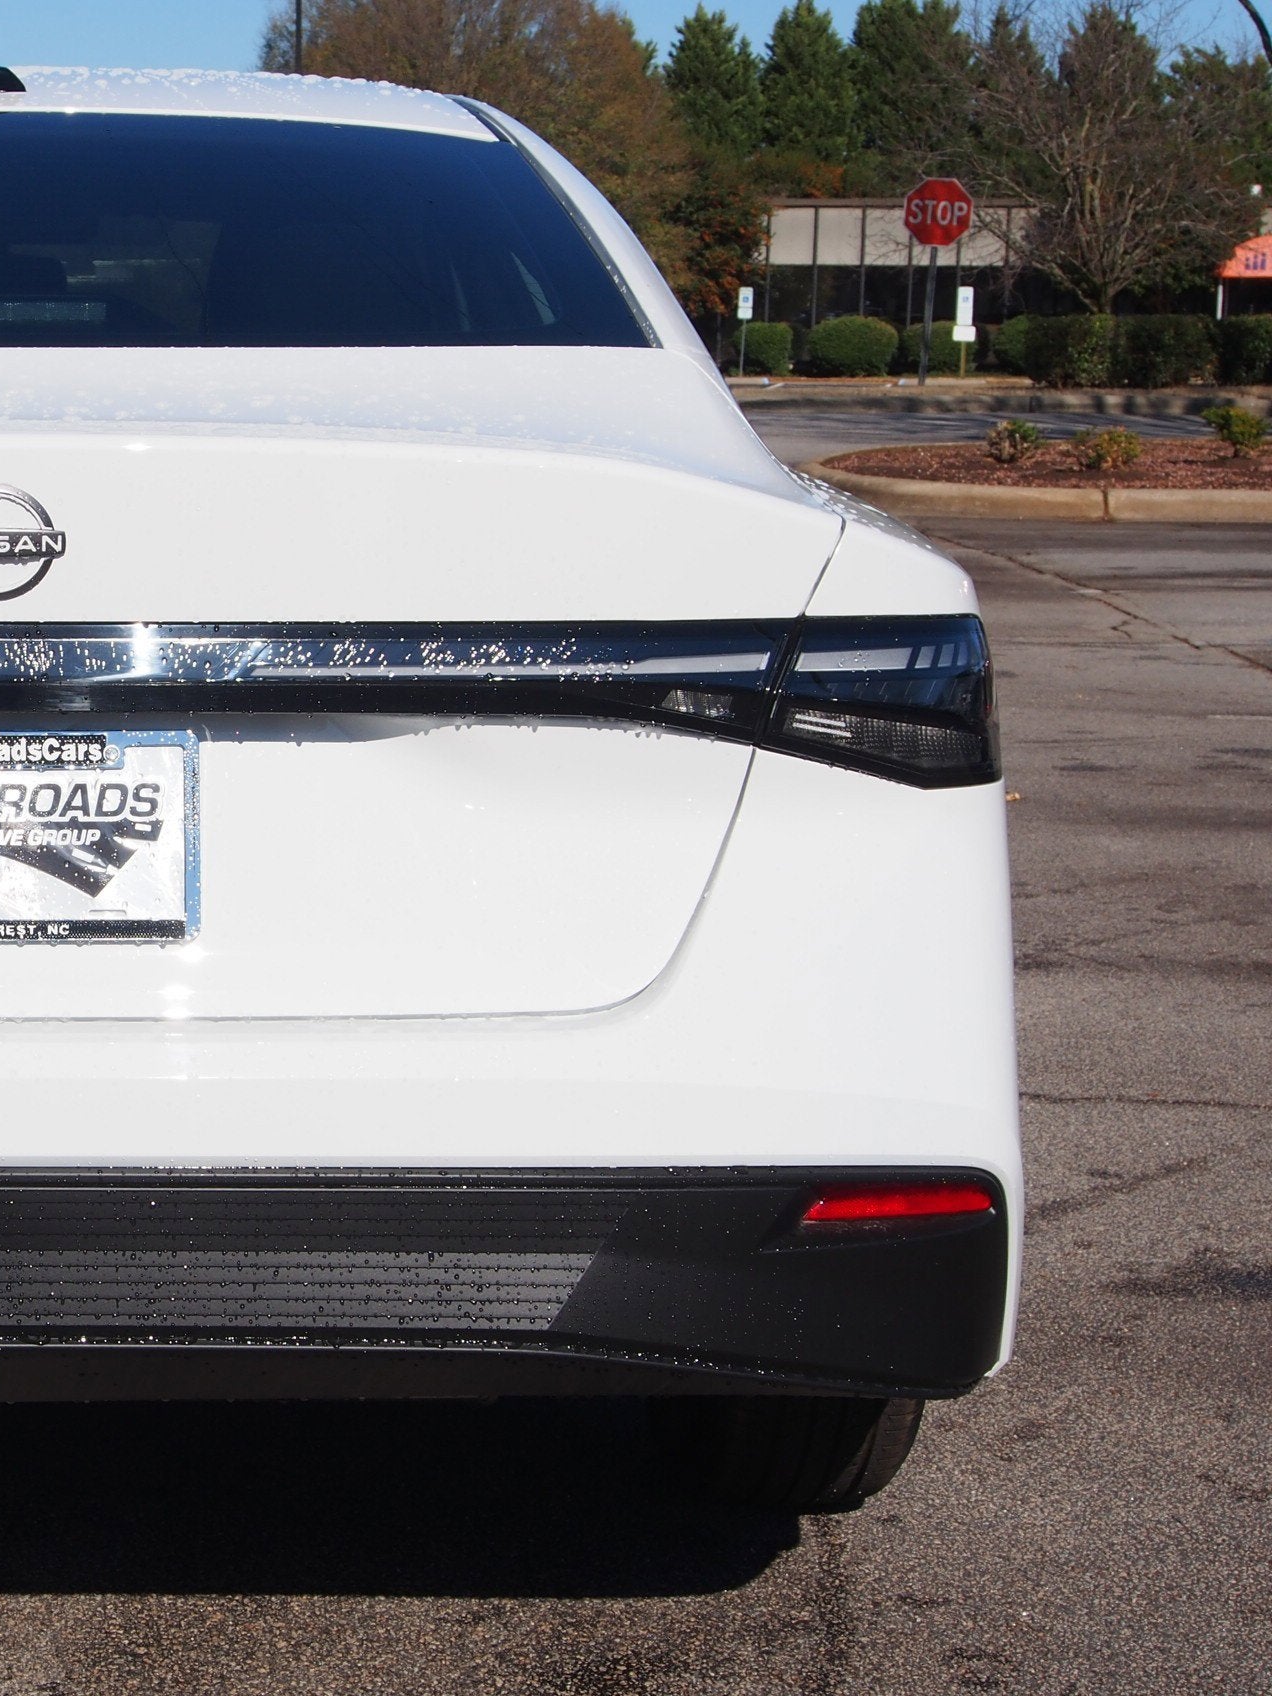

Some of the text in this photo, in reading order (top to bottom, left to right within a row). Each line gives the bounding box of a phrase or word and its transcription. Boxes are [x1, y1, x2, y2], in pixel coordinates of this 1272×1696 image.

[909, 199, 968, 225] STOP
[27, 829, 101, 846] GROUP
[46, 924, 70, 936] NC
